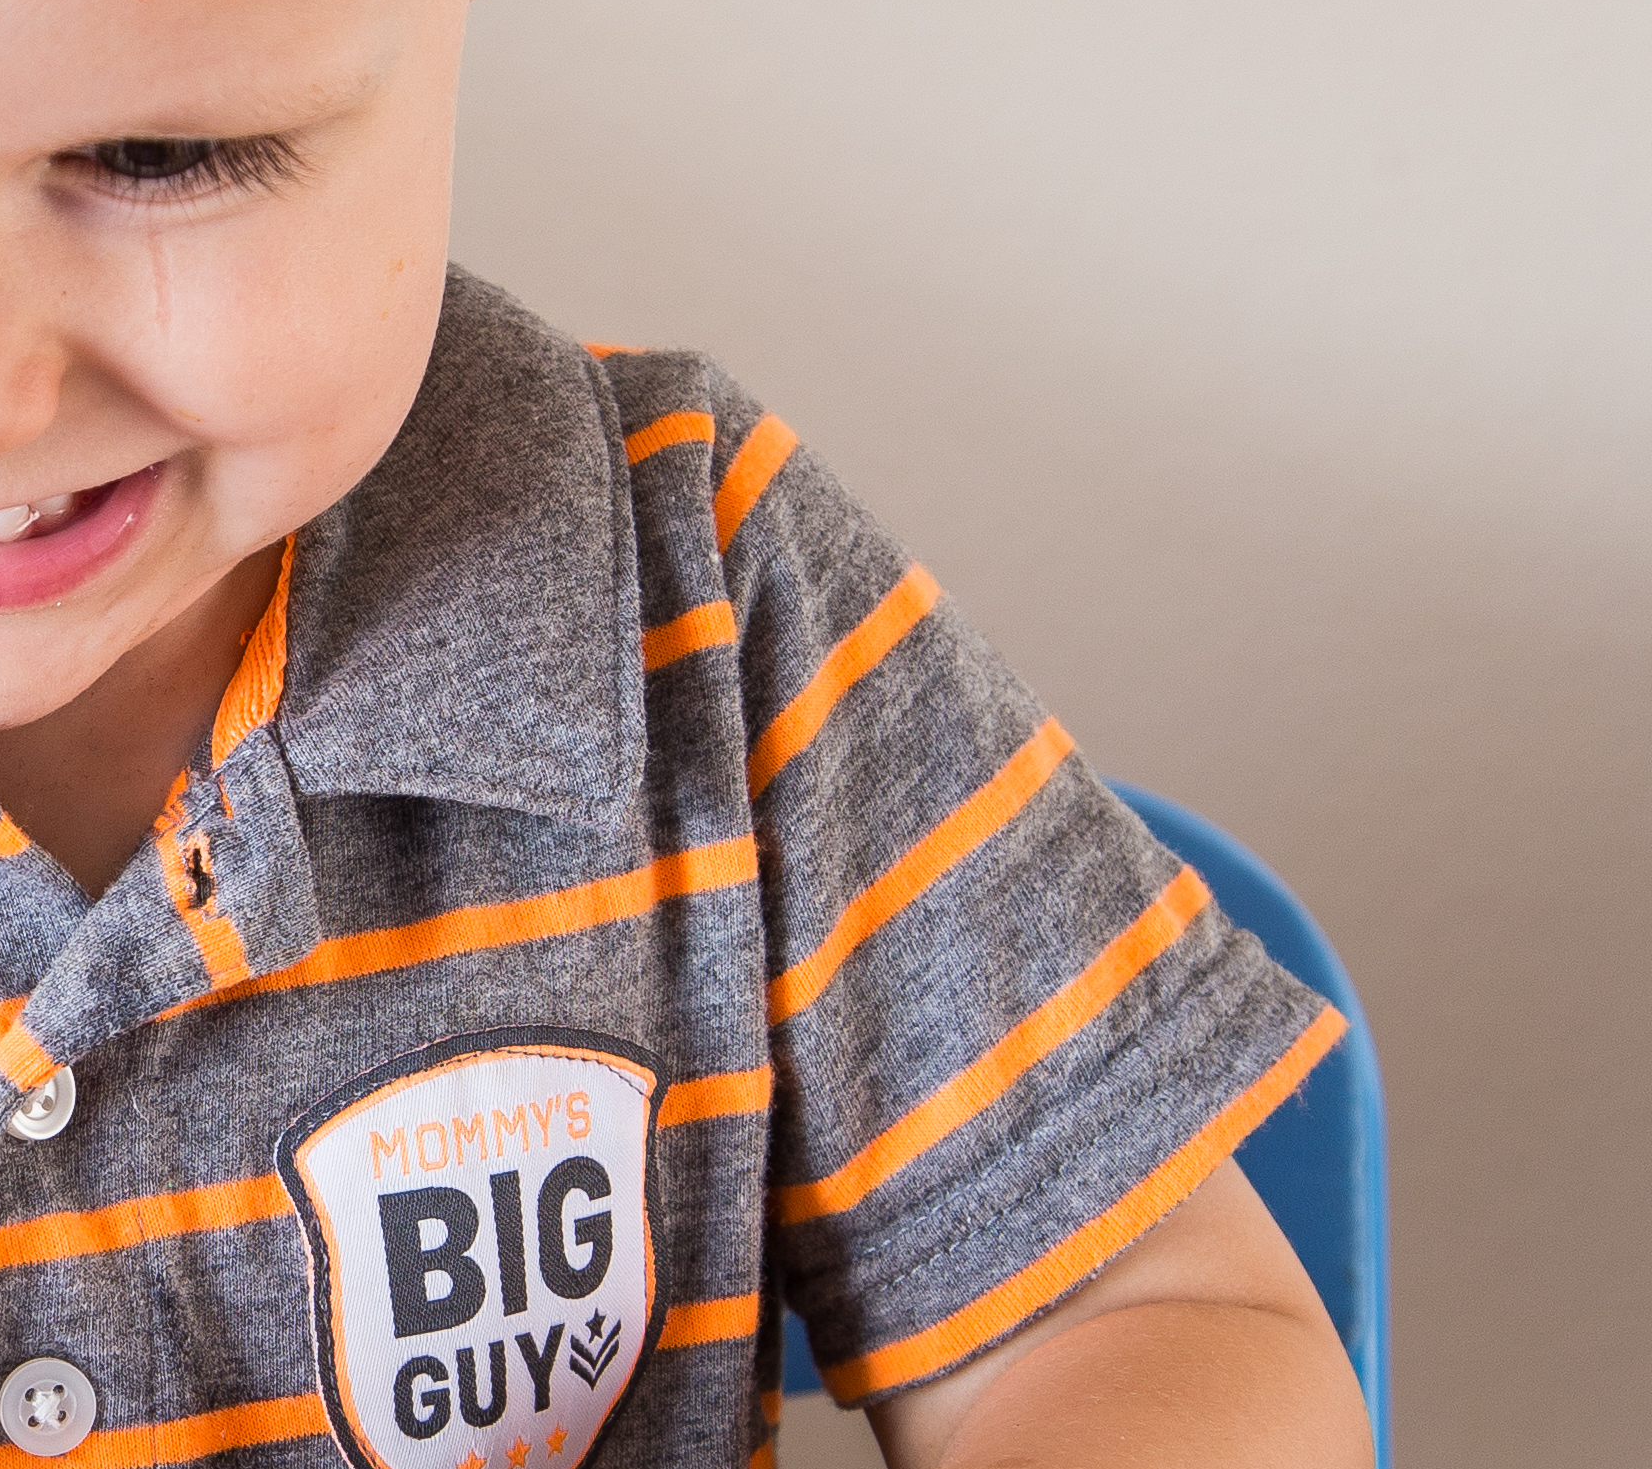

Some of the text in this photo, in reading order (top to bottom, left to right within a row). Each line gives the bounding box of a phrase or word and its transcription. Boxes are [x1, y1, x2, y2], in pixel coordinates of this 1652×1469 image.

[369, 1090, 592, 1179] MOMMY'S
[377, 1155, 613, 1339] BIG
[393, 1323, 566, 1440] GUY
